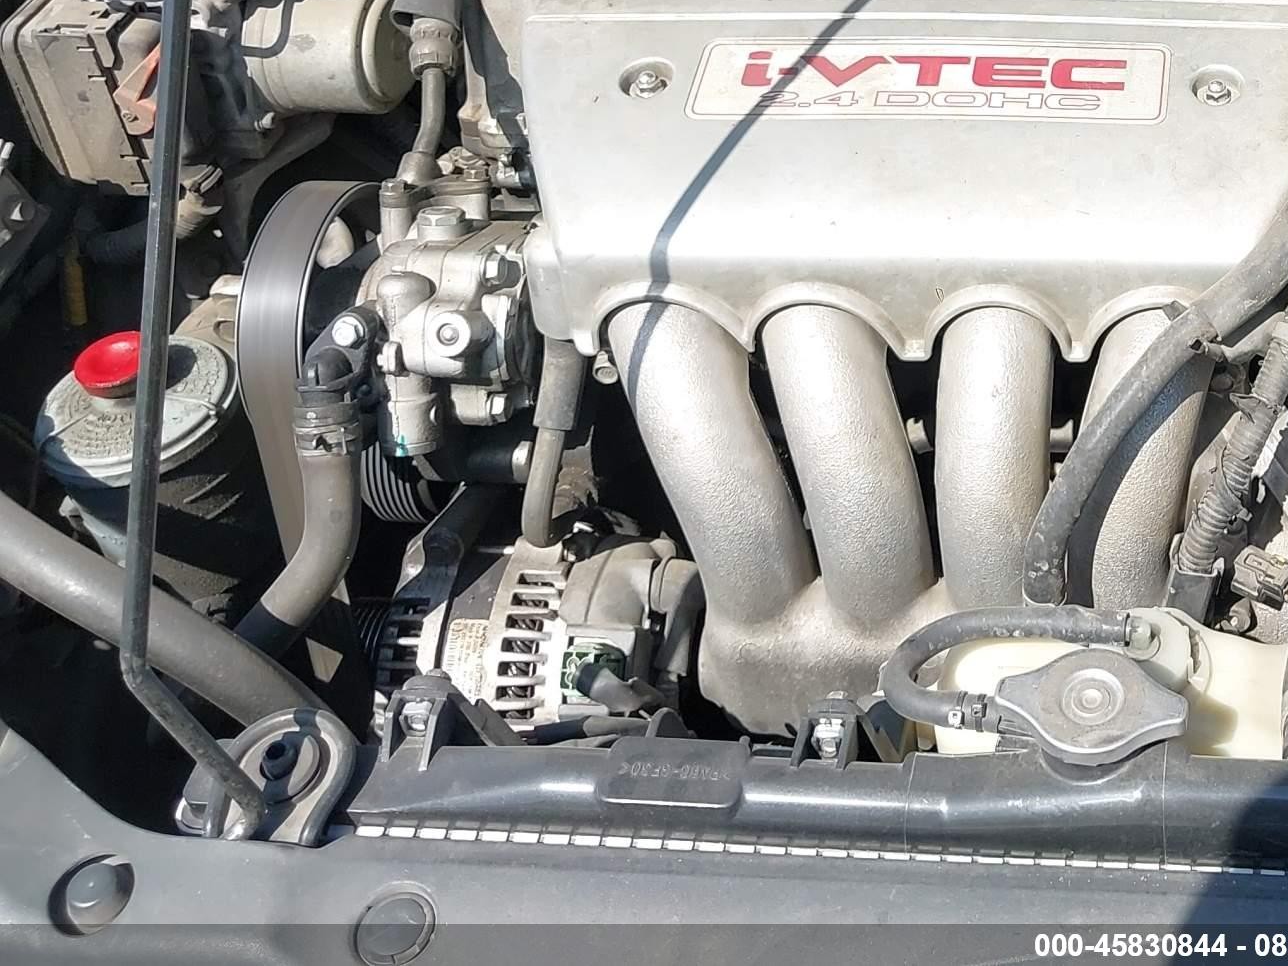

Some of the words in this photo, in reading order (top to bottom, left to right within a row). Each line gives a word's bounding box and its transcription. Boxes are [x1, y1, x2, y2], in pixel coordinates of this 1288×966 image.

[741, 50, 1127, 91] i-VTEC
[757, 90, 859, 109] 2.4
[873, 91, 1102, 111] DOHC
